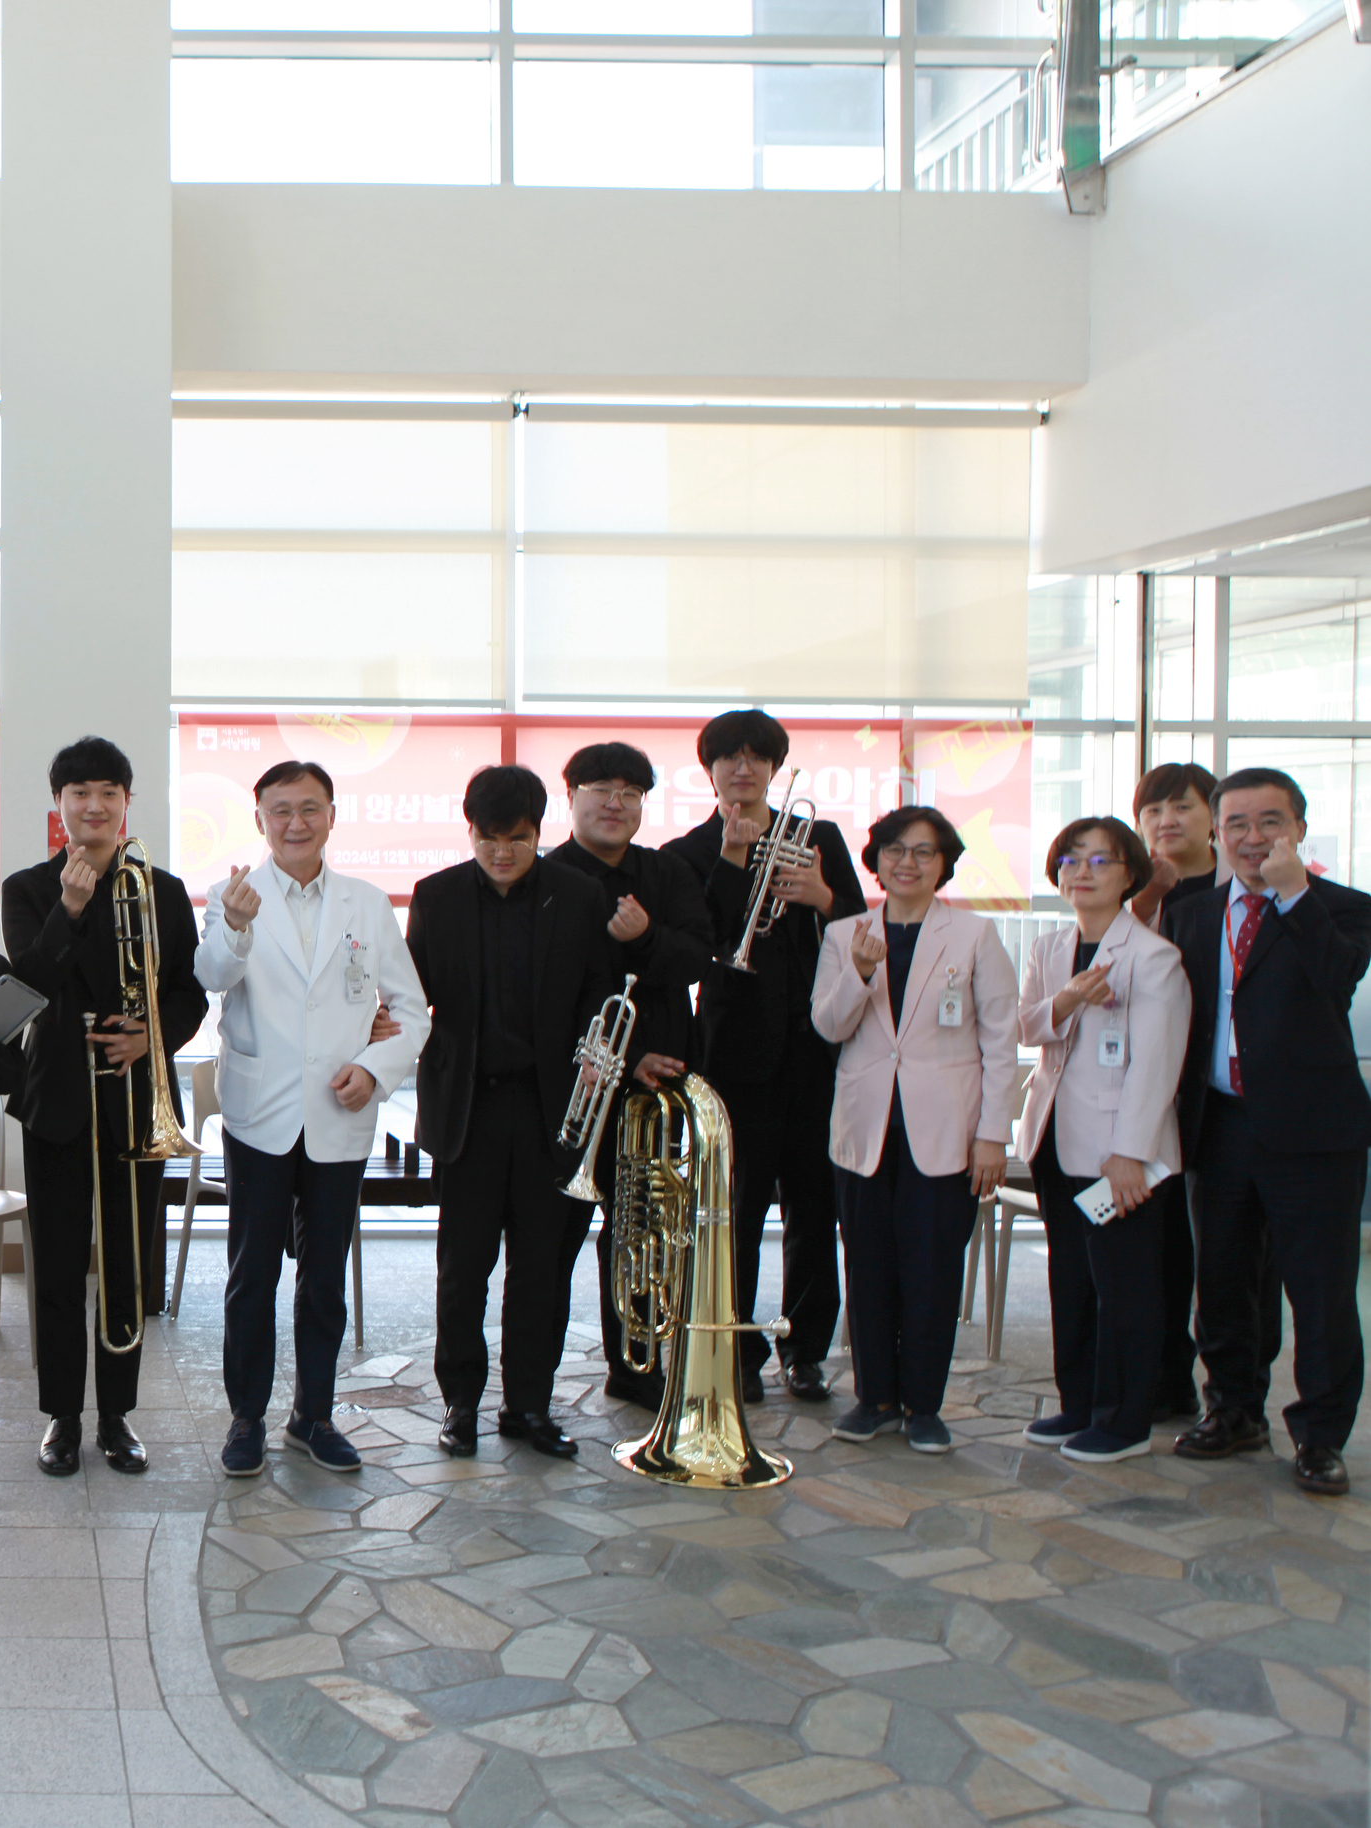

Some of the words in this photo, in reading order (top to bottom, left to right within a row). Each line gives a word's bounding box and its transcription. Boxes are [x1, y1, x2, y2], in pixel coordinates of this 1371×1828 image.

[221, 737, 261, 751] 서남병원
[333, 849, 380, 865] 2024년
[383, 849, 409, 865] 12월
